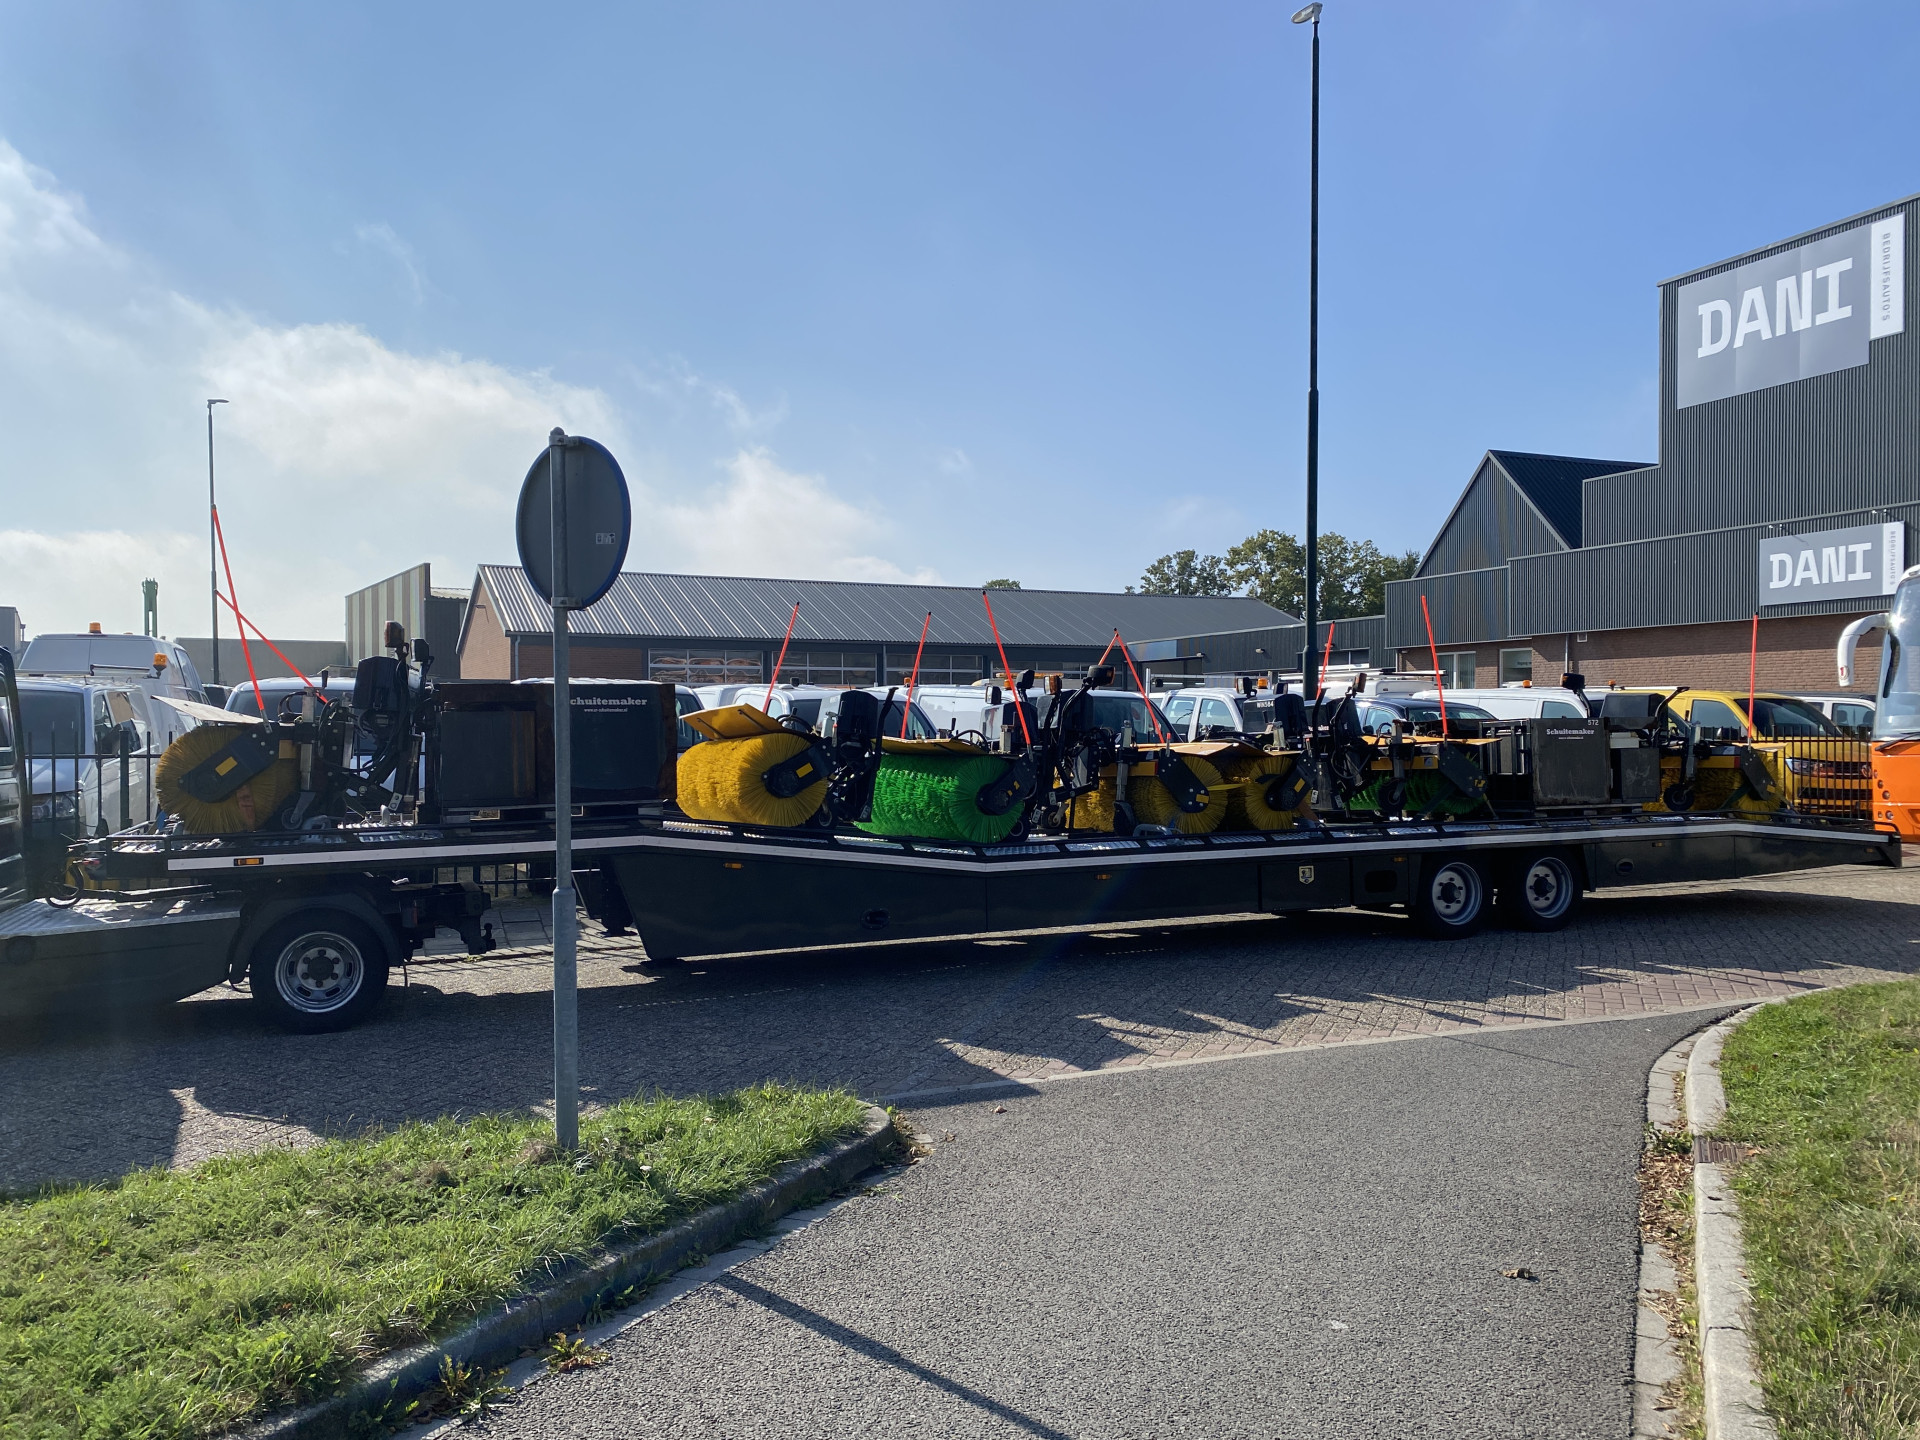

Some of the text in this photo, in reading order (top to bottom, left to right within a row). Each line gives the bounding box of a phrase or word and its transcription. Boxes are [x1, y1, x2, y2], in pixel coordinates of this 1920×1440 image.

[1697, 257, 1853, 359] DANI
[1881, 232, 1891, 322] BEDRIJFSAUTO'S
[1769, 542, 1872, 589] DANI
[569, 696, 648, 706] chuitemaker
